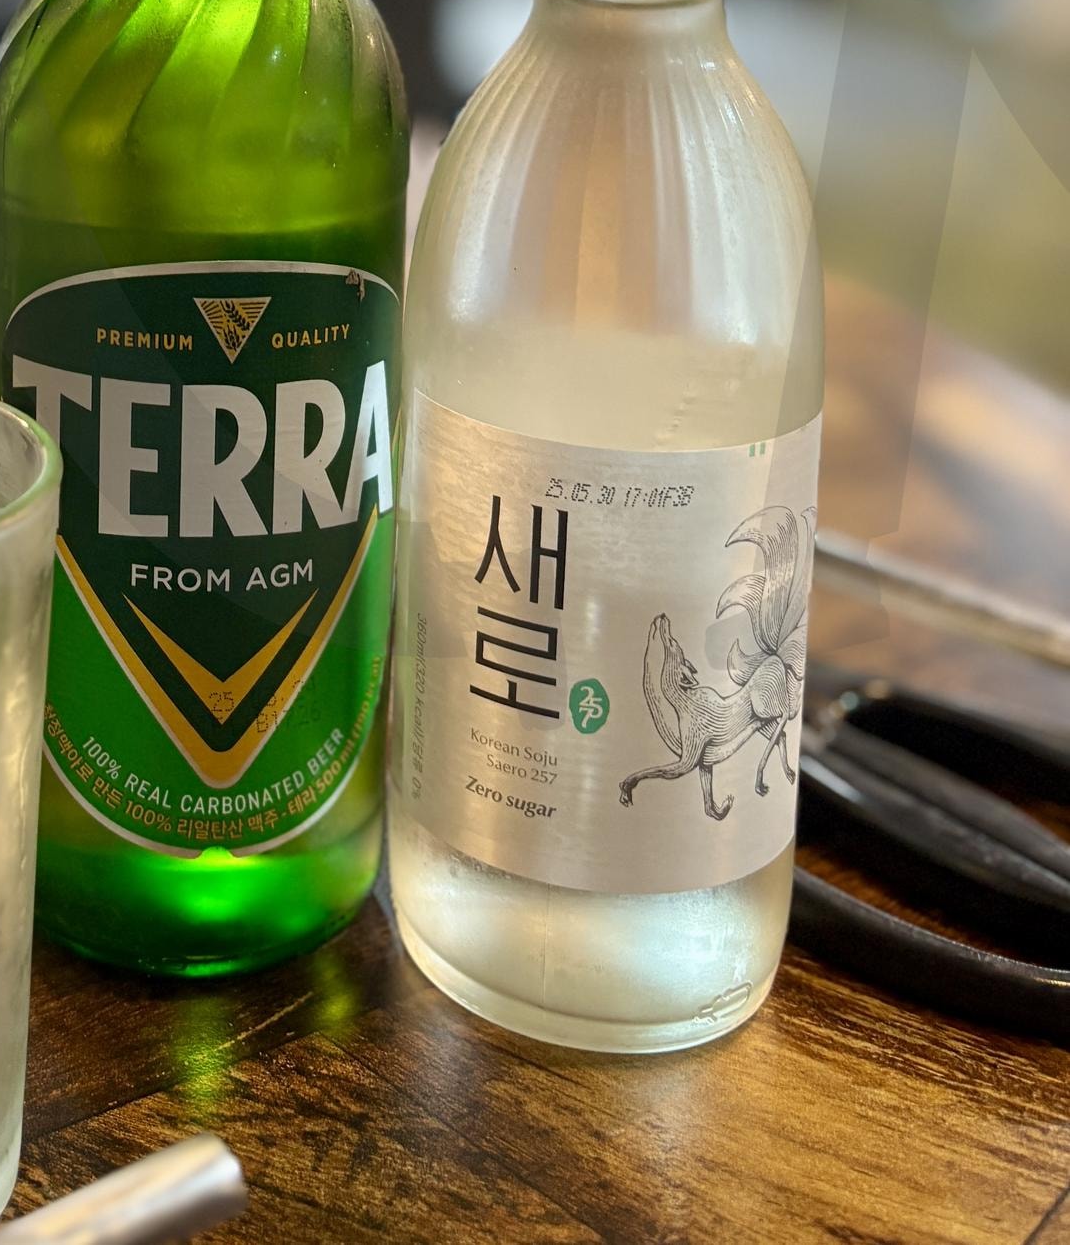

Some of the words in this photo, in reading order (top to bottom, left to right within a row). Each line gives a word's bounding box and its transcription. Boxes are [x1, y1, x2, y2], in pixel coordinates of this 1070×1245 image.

[96, 326, 194, 351] PREMIUM
[271, 322, 351, 349] QUALITY
[12, 355, 393, 539] TERRA
[131, 563, 231, 593] FROM
[245, 558, 313, 591] AGM
[469, 495, 570, 720] 새로
[470, 727, 521, 759] Korean
[523, 741, 559, 768] Soju
[485, 753, 528, 781] Saero
[529, 765, 558, 786] 257
[81, 735, 122, 780] 100%
[124, 772, 172, 809] REAL
[180, 770, 305, 816] CARBONATED
[306, 727, 345, 777] BEER
[91, 778, 126, 810] 만든
[124, 800, 172, 834] 100%
[177, 818, 245, 841] 리얼탄산
[248, 808, 279, 834] 맥주
[287, 789, 318, 817] 테라
[465, 774, 503, 803] Zero
[506, 793, 558, 819] sugar
